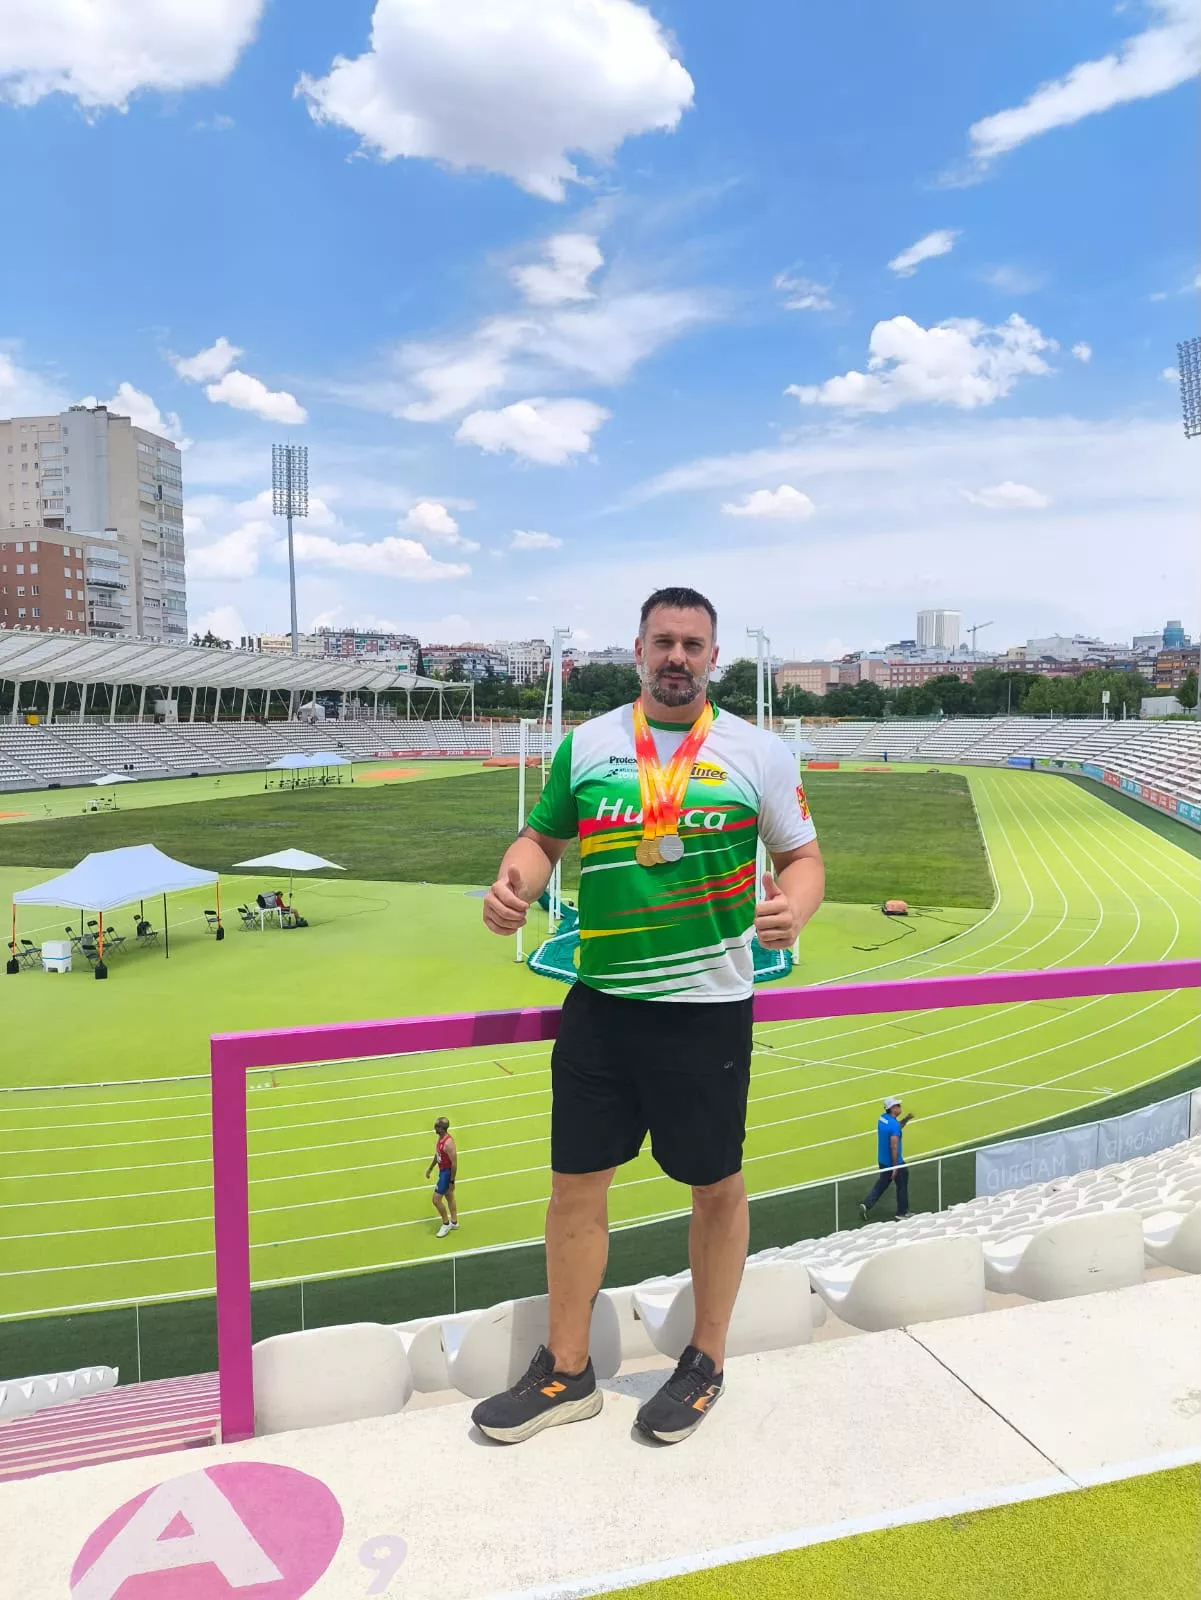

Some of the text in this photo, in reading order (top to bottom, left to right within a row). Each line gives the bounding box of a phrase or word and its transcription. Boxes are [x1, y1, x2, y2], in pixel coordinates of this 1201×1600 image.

[596, 797, 727, 830] Huca
[71, 1467, 285, 1600] A
[358, 1533, 408, 1595] 9
